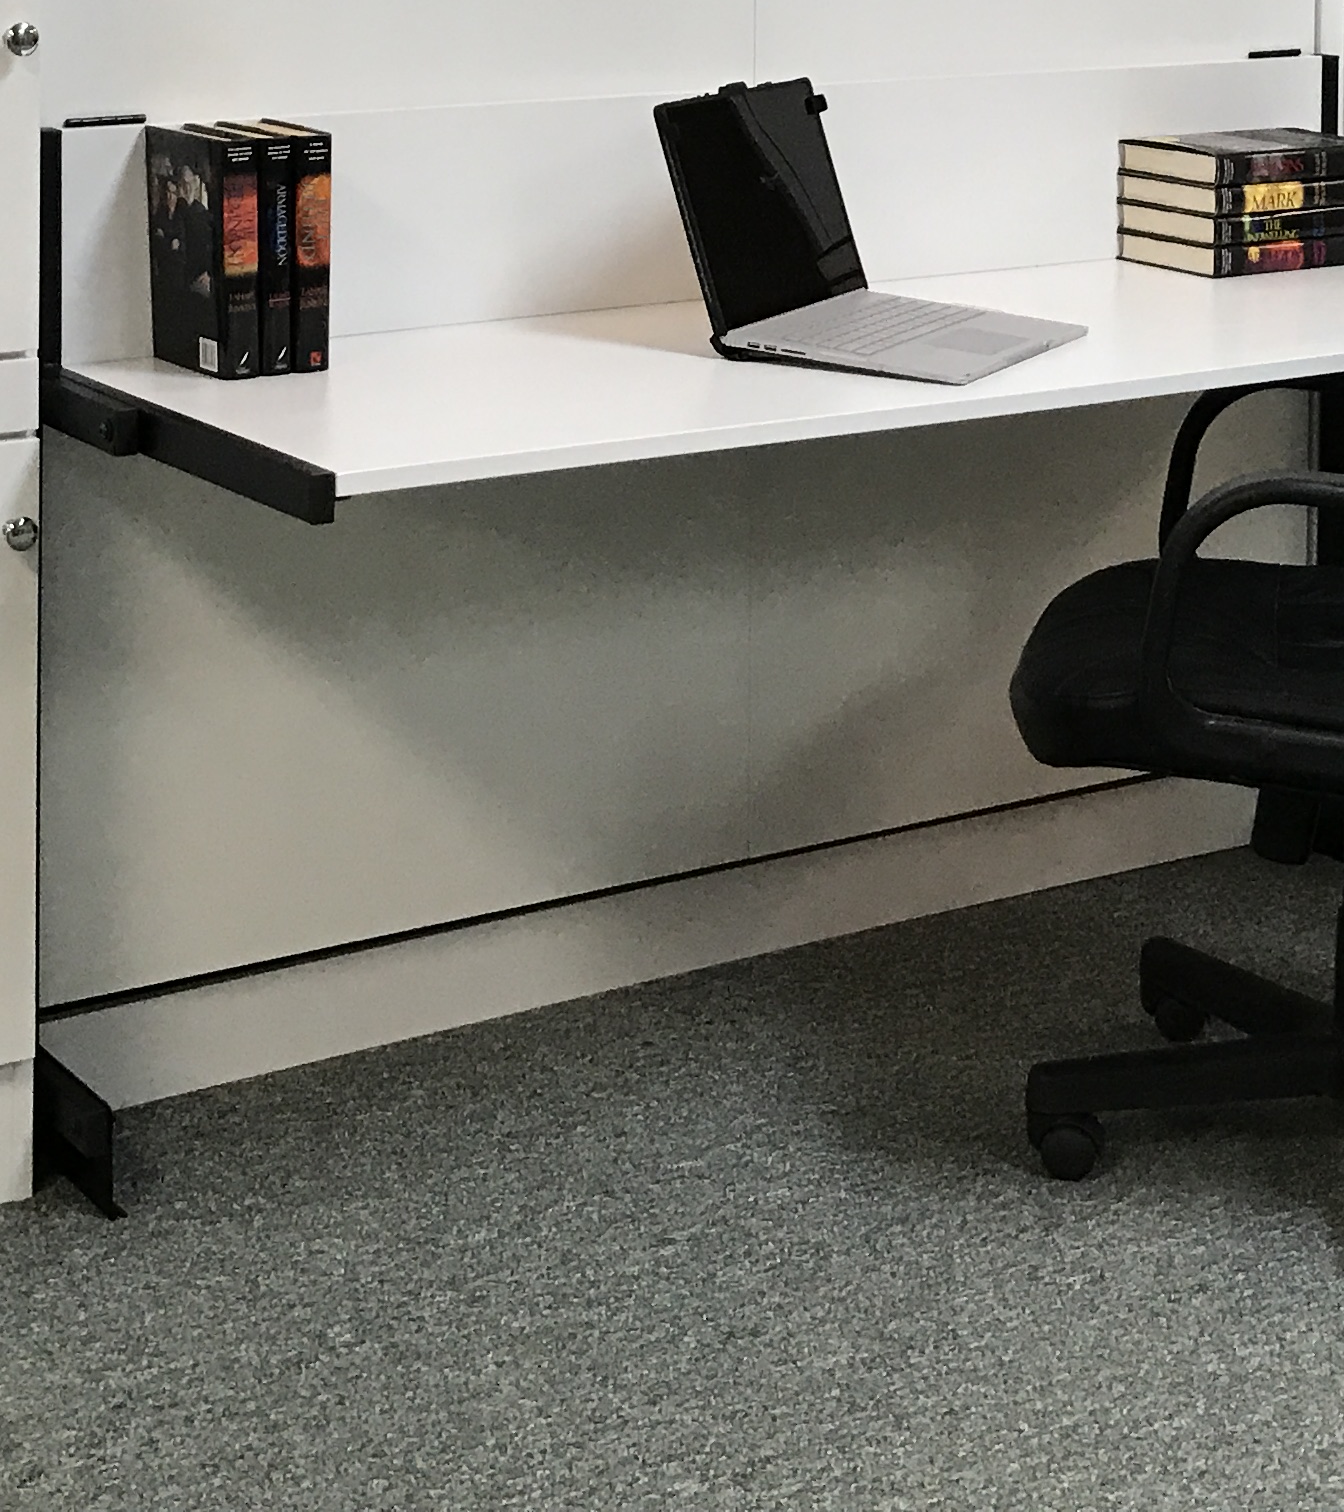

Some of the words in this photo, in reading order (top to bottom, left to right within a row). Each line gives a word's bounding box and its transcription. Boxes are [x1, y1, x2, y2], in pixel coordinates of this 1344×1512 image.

[1251, 191, 1297, 211] MARK
[275, 184, 288, 266] ARMAGEDDON
[1264, 219, 1281, 231] THE
